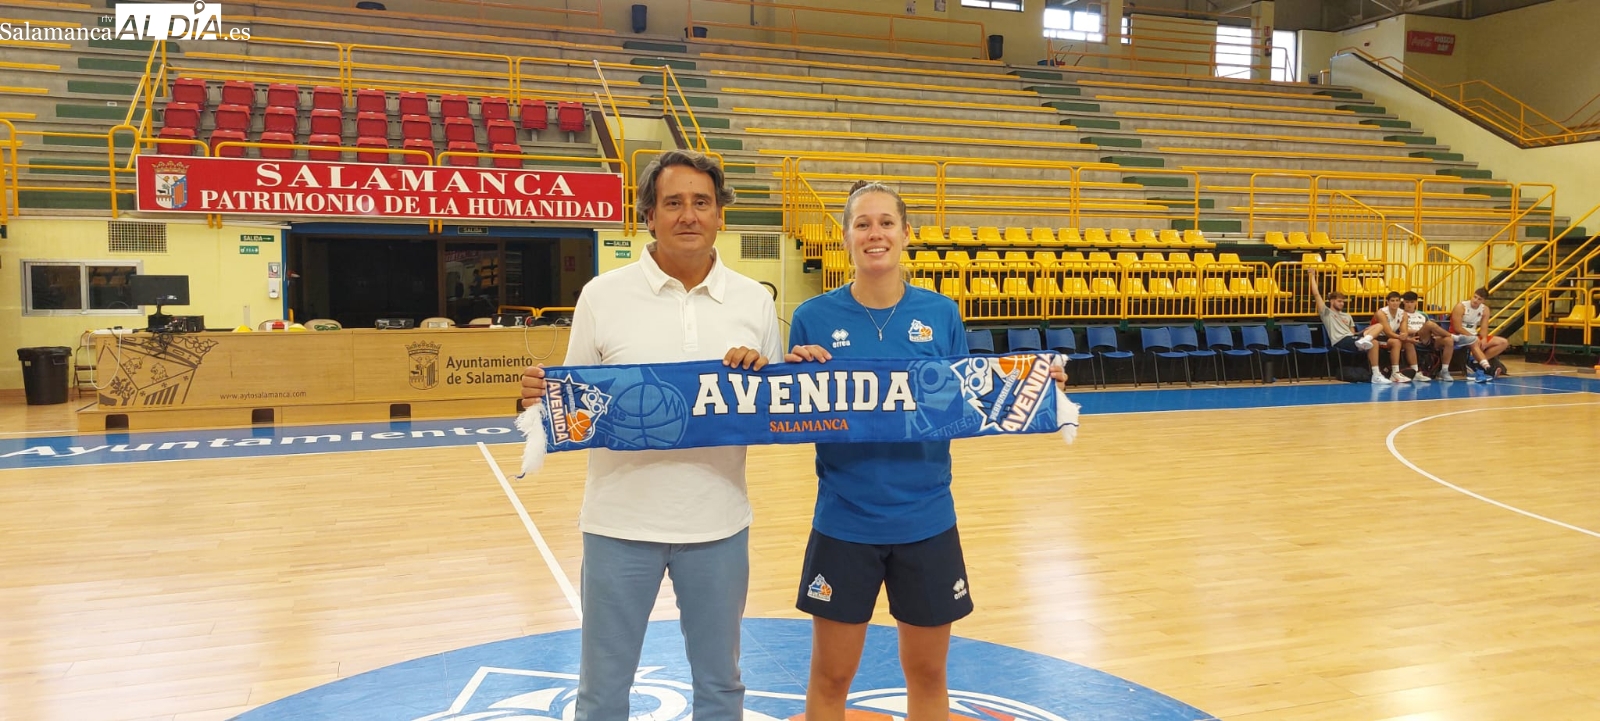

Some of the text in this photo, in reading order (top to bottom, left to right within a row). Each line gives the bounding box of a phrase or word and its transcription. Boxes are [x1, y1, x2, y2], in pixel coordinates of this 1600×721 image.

[256, 163, 576, 197] SALAMANCA
[200, 189, 614, 219] PATRIMONIO DE LA HUMANIDAD
[446, 355, 533, 371] Ayuntamiento
[446, 371, 525, 385] de Salamanc
[220, 391, 307, 400] www.aytosalamanca.com
[692, 371, 917, 416] AVENIDA
[547, 382, 569, 442] AVENIDA
[769, 418, 849, 433] SALAMANCA
[1, 426, 512, 458] Ayuntamiento
